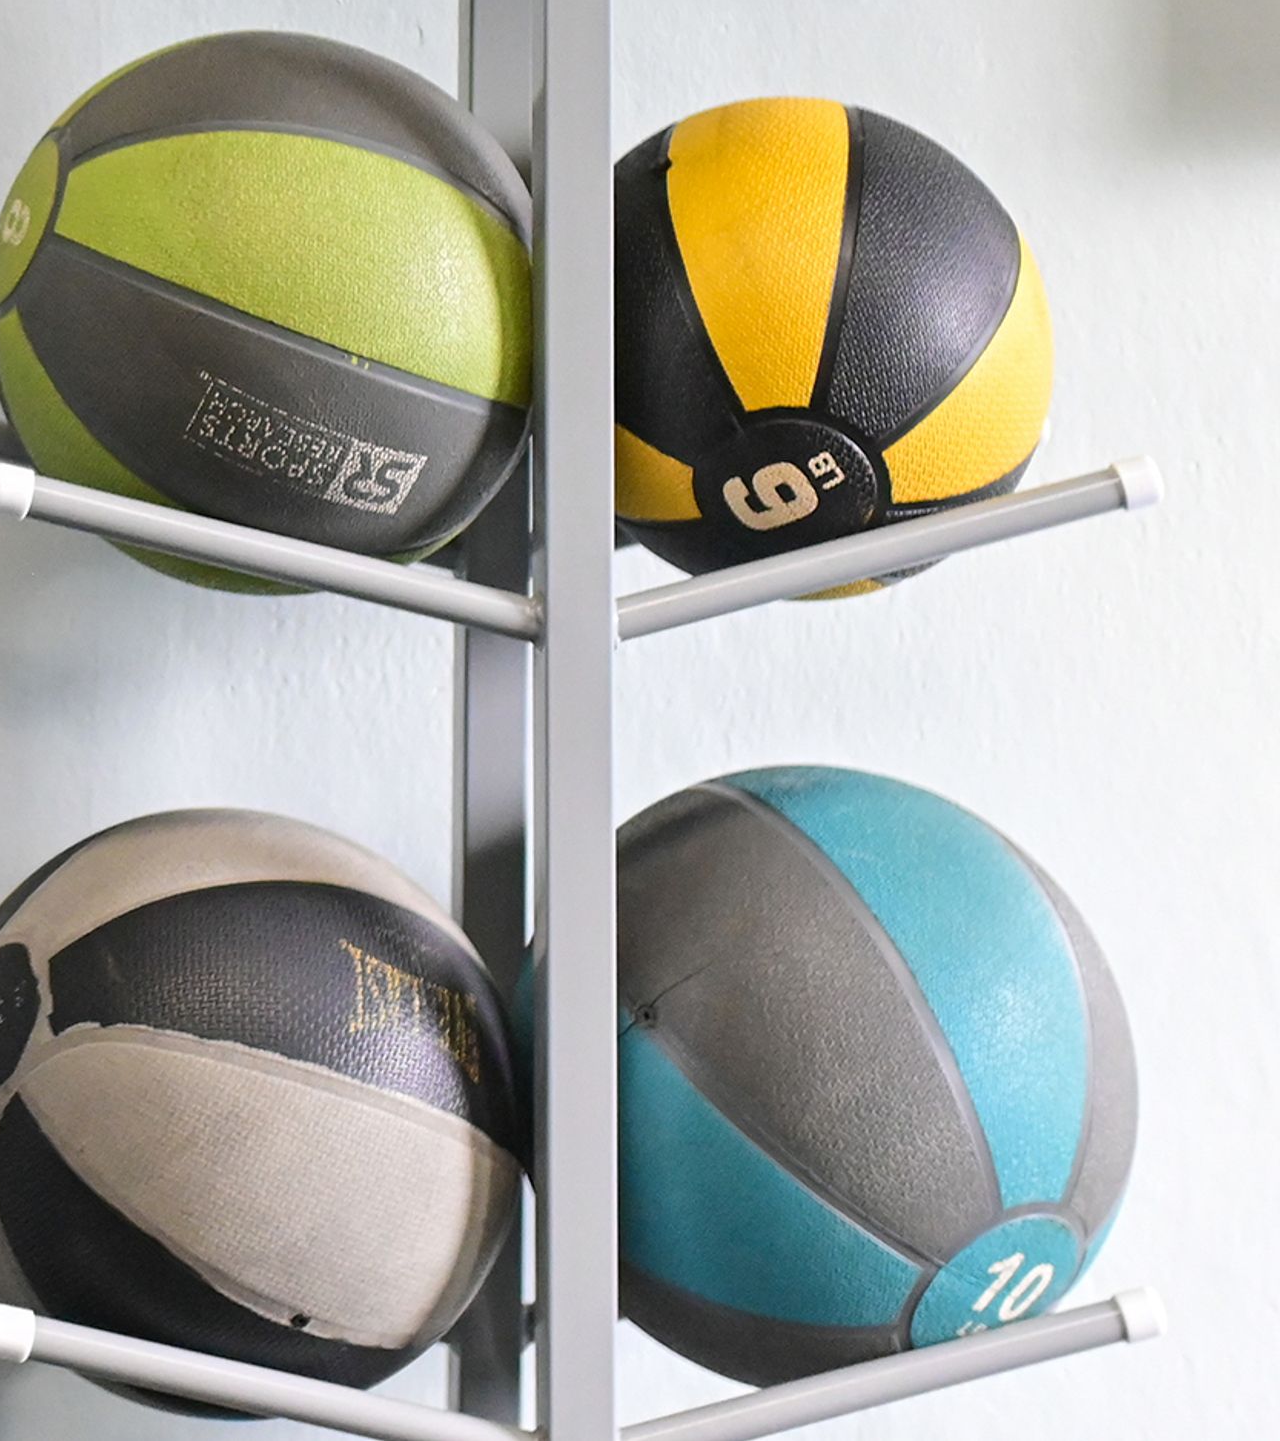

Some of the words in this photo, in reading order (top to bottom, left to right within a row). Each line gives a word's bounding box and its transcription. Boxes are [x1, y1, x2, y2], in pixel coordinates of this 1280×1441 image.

[198, 413, 334, 487] SPORTS
[807, 450, 846, 490] LB
[971, 1252, 1054, 1321] 10
